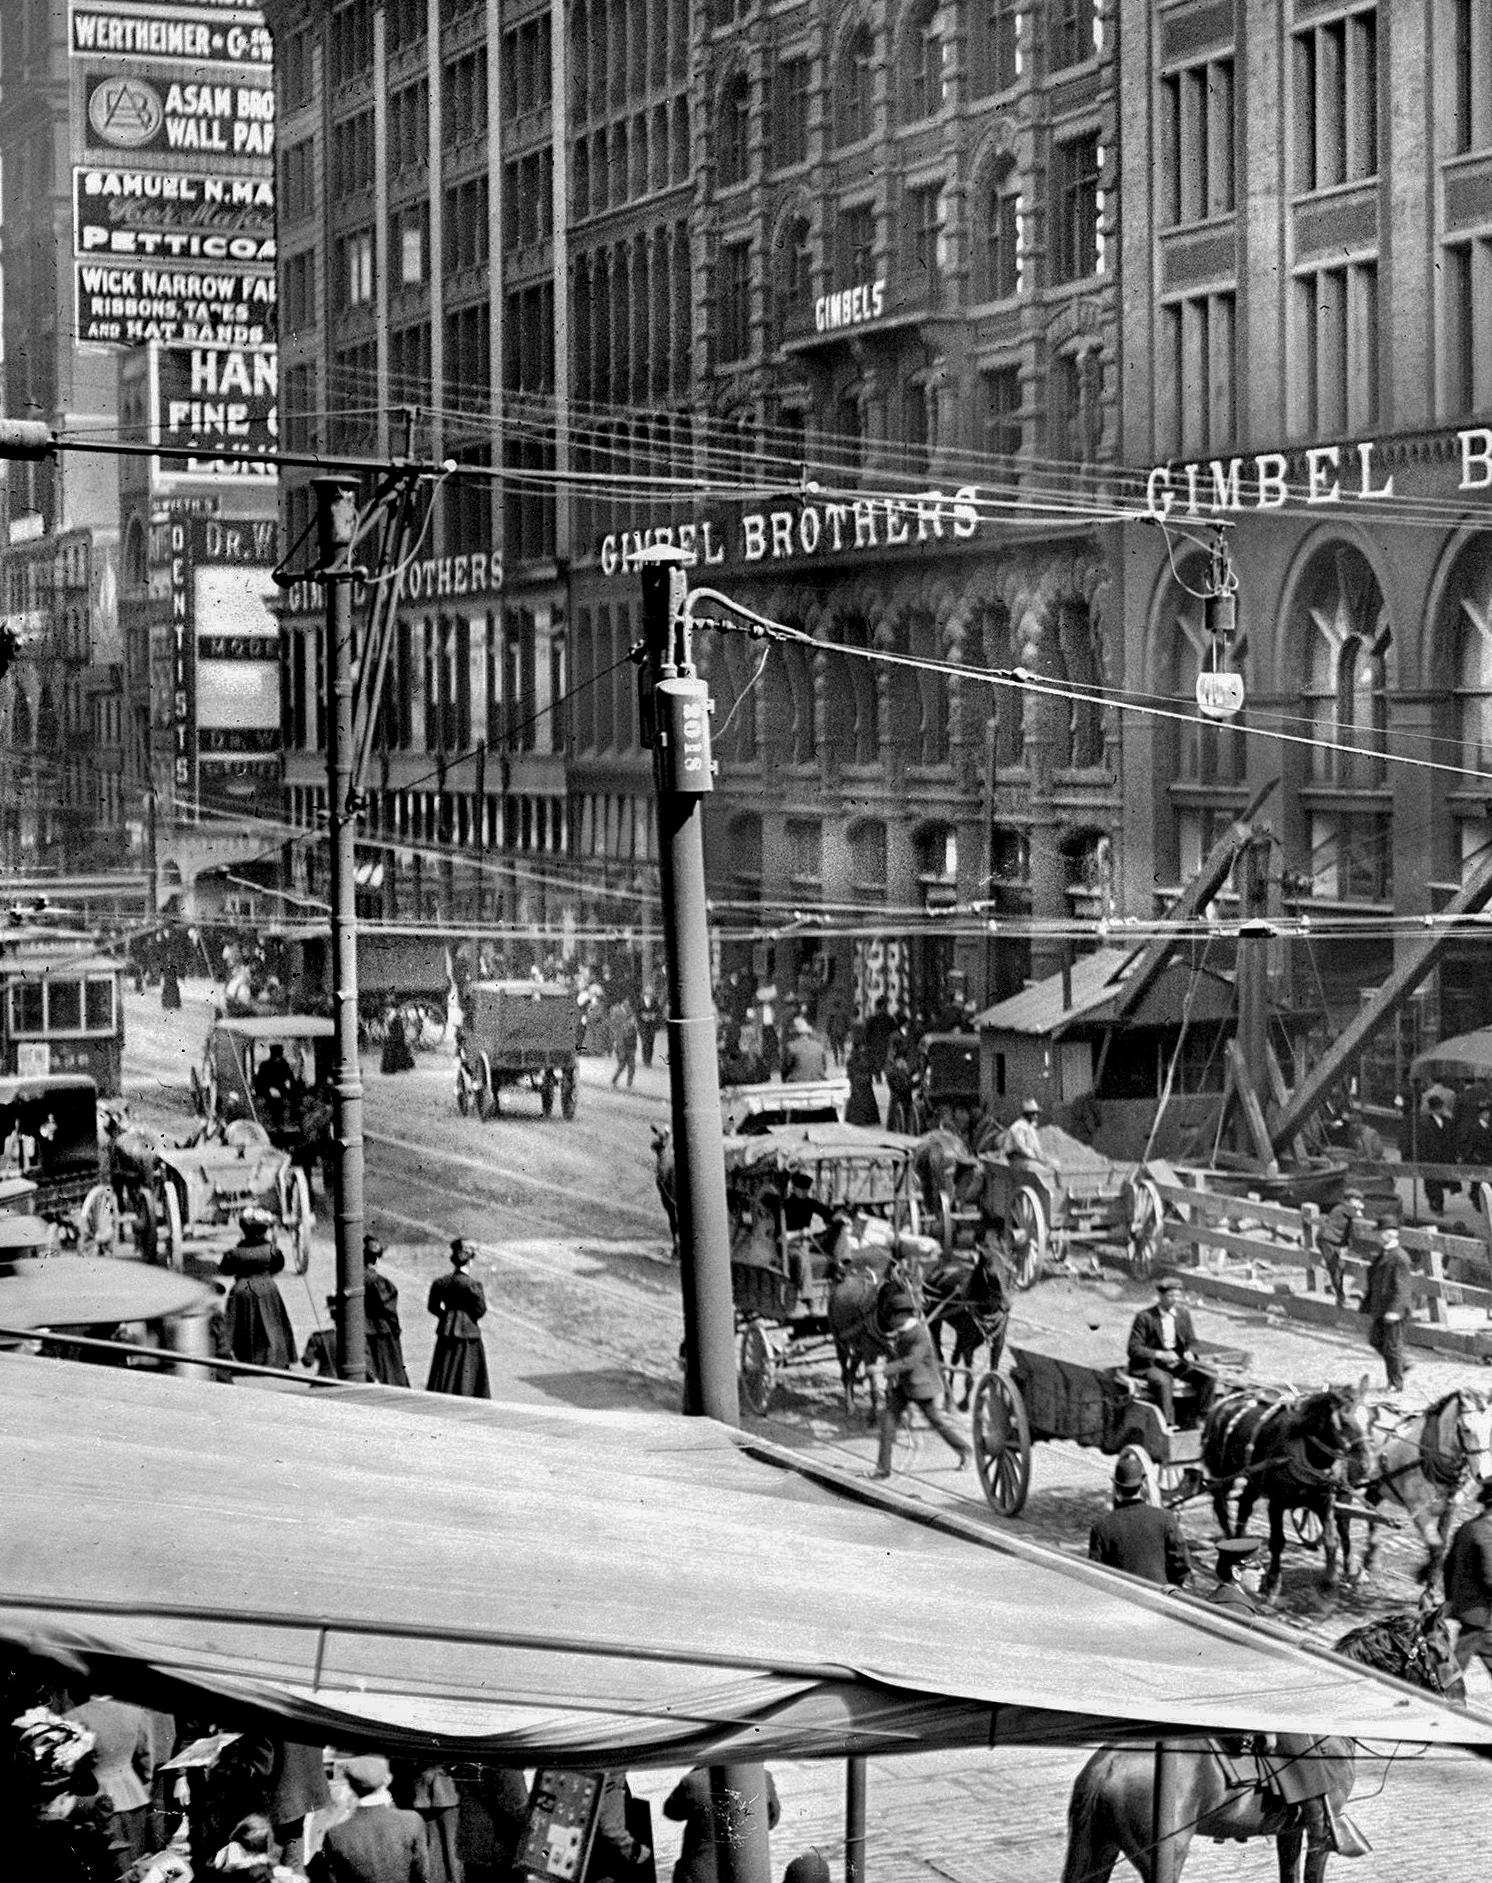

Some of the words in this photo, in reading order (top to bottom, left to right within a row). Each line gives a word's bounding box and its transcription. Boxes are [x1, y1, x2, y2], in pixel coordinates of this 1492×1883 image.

[75, 15, 210, 57] WERTHEIMER
[165, 83, 231, 117] ASAM
[165, 118, 228, 151] WALL
[84, 172, 197, 200] SAMUEL
[83, 225, 277, 256] PETTICOA
[82, 267, 137, 295] WICK
[142, 271, 236, 300] NARROW
[815, 278, 885, 332] GIMBELS
[87, 321, 121, 339] AND
[126, 319, 178, 341] HAT
[182, 323, 264, 344] BANDS
[191, 349, 278, 397] HAN
[168, 401, 250, 436] FINE
[1147, 442, 1394, 520] GIMBEL
[742, 486, 980, 560] BROTHERS
[378, 549, 504, 604] OTHERS
[171, 524, 190, 784] DENTISTS
